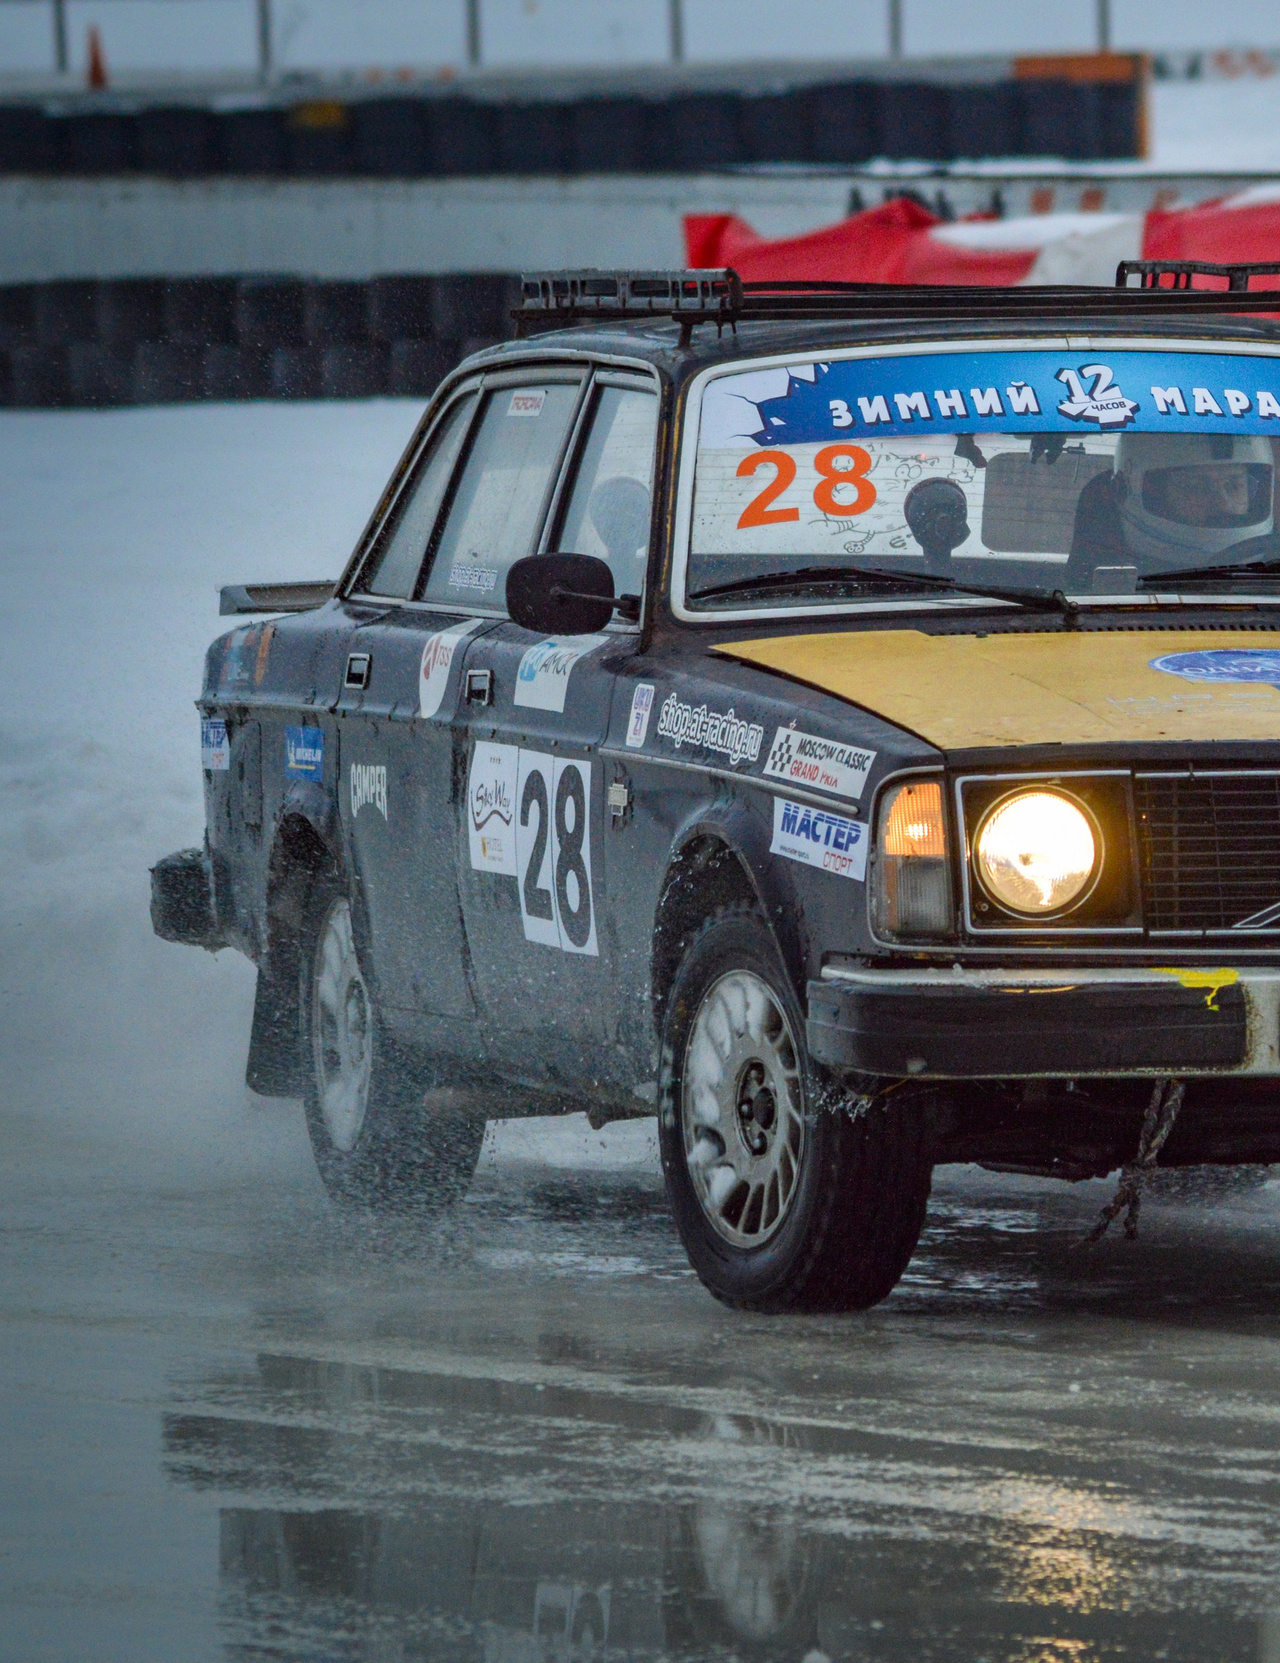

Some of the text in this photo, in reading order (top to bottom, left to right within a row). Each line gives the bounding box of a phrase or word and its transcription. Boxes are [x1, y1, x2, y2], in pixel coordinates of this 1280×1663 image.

[829, 380, 1041, 428] ЗИМНИЙ
[1056, 364, 1121, 403] 12
[1091, 400, 1127, 412] ЧАСОВ
[736, 444, 877, 530] 28
[658, 692, 763, 765] shop.at-racing.ru
[796, 738, 871, 772] MOSCOW CLASSIC
[351, 763, 388, 821] CAMPER
[790, 760, 819, 782] GRAND
[781, 802, 862, 852] МАСТЕР
[520, 764, 592, 948] 28
[823, 851, 854, 874] СПОРТ
